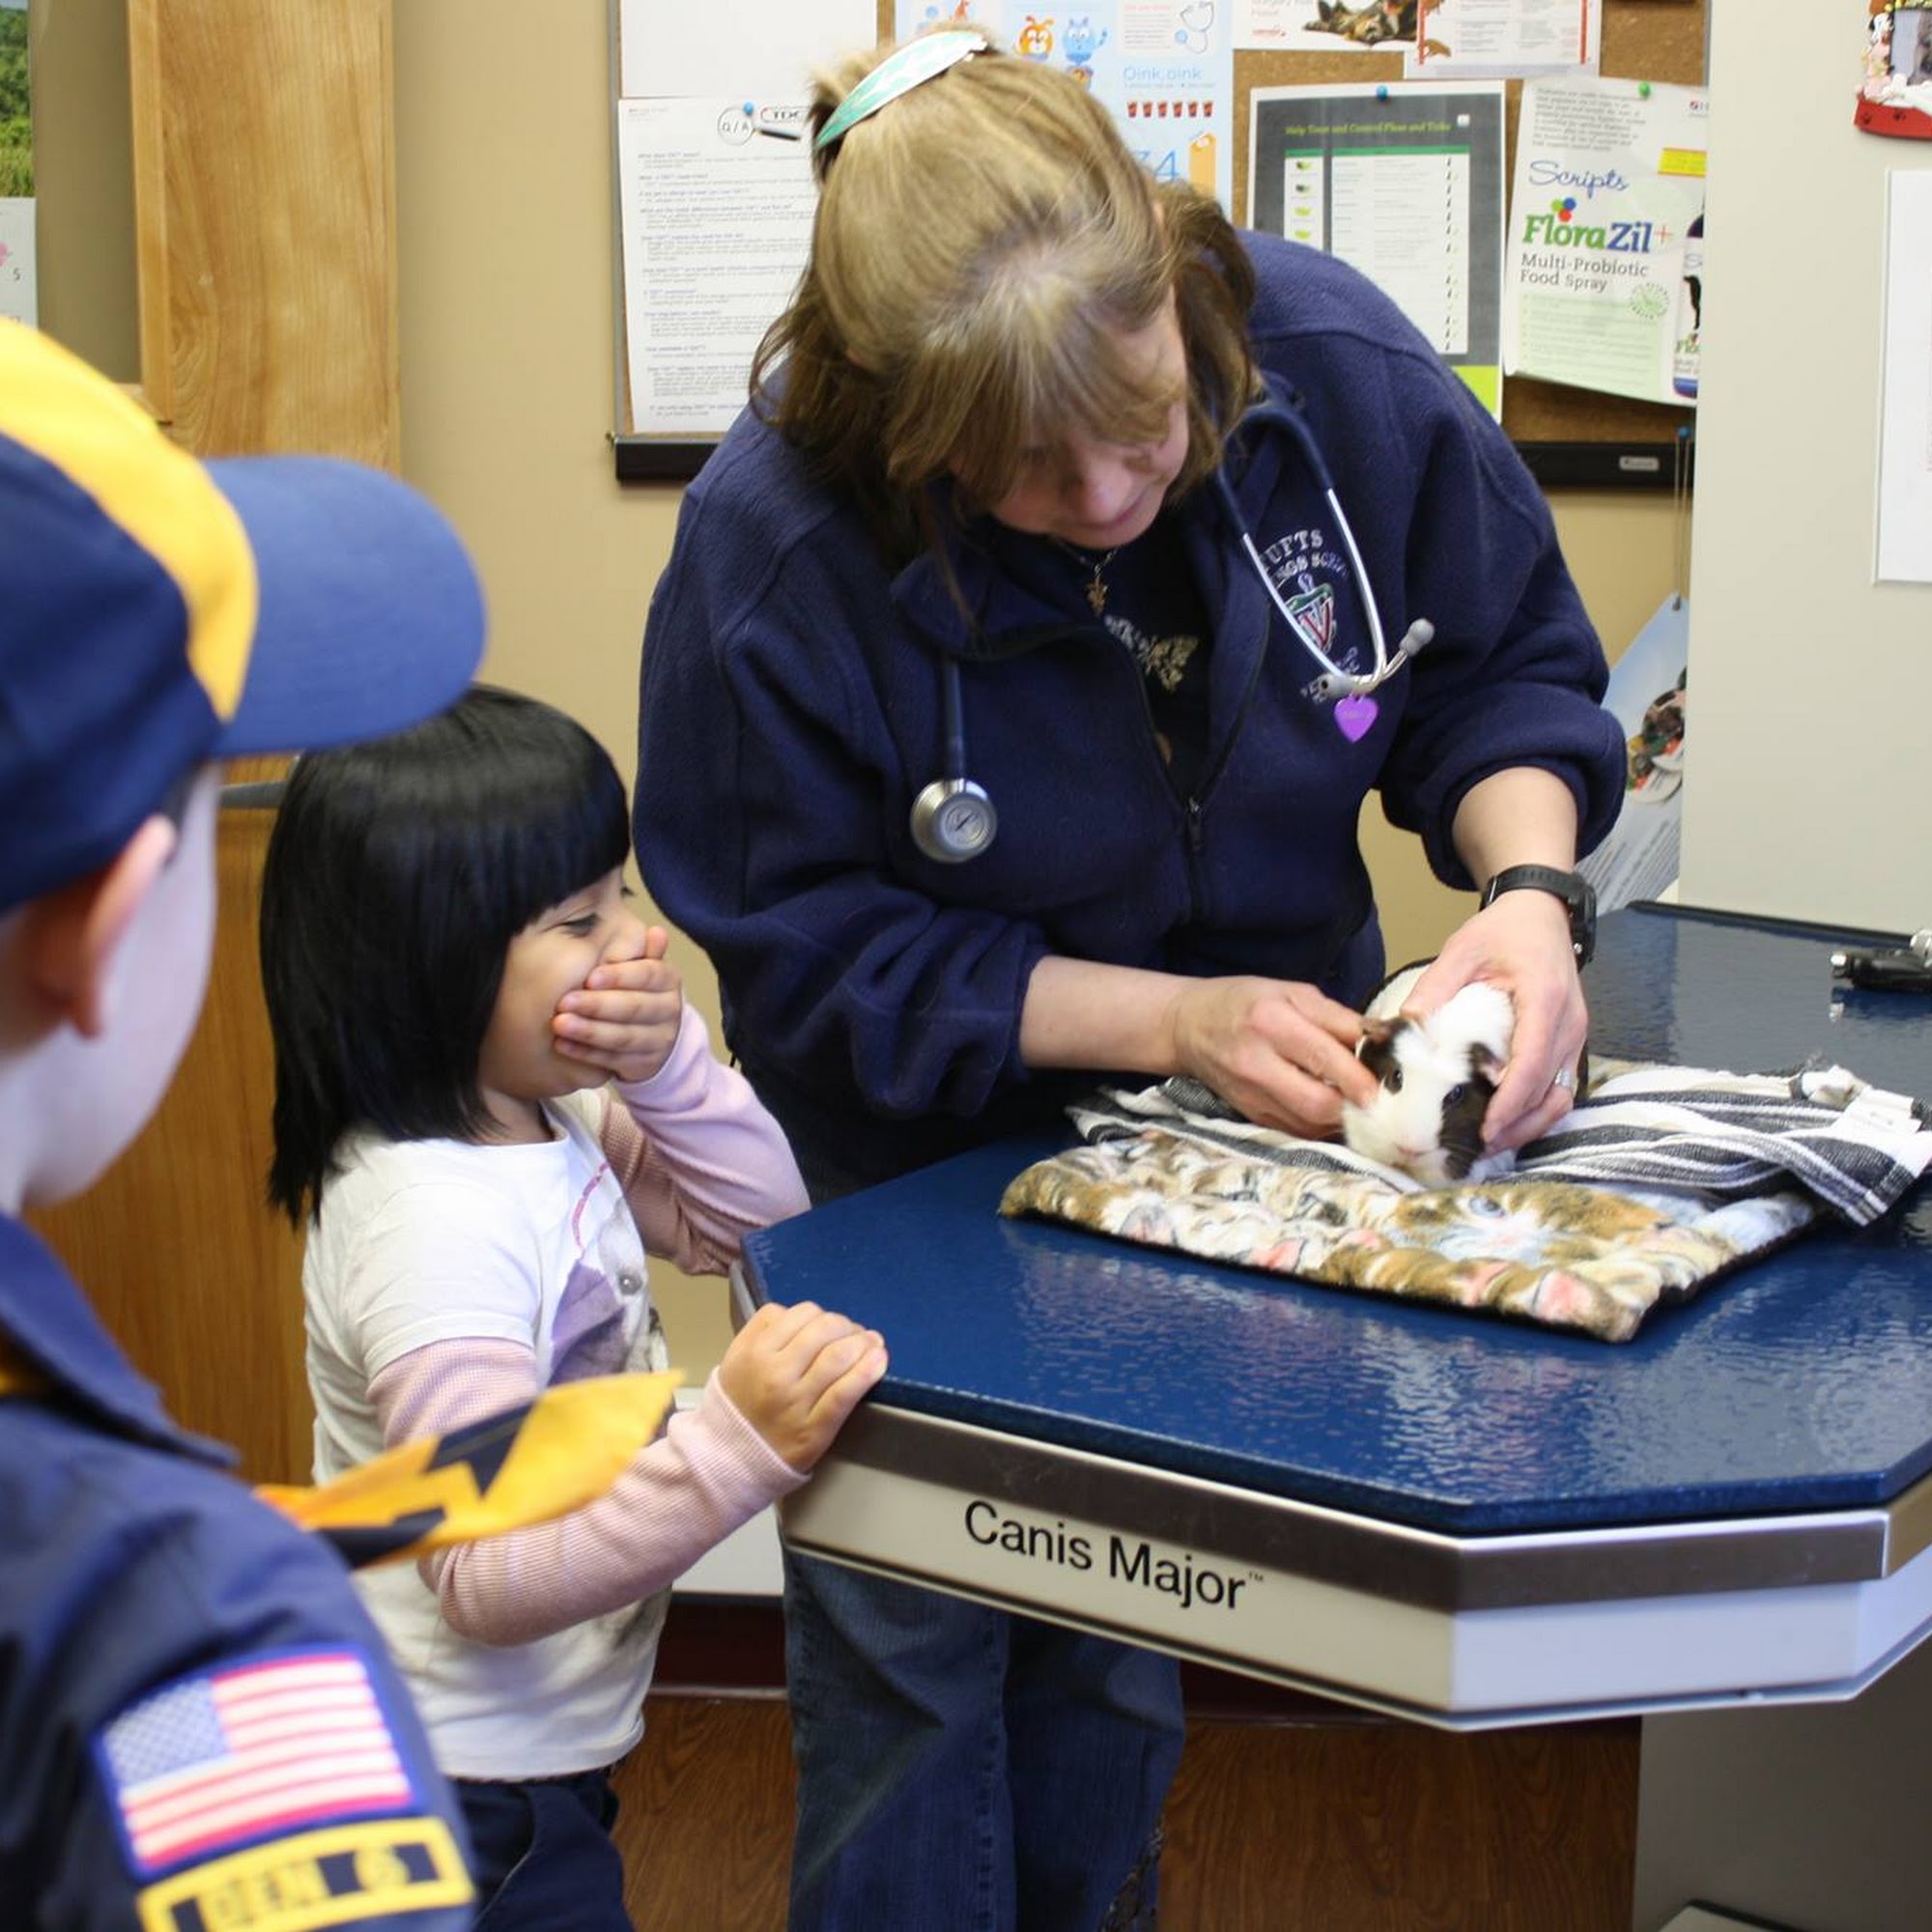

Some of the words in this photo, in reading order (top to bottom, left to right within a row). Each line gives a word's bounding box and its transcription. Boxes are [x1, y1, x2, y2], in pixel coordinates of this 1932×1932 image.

[1529, 160, 1630, 199] Scripts
[1520, 253, 1650, 277] Multi-Probiotic
[1520, 270, 1561, 287] Food
[1565, 273, 1608, 294] Spray
[964, 1500, 1093, 1571] Canis
